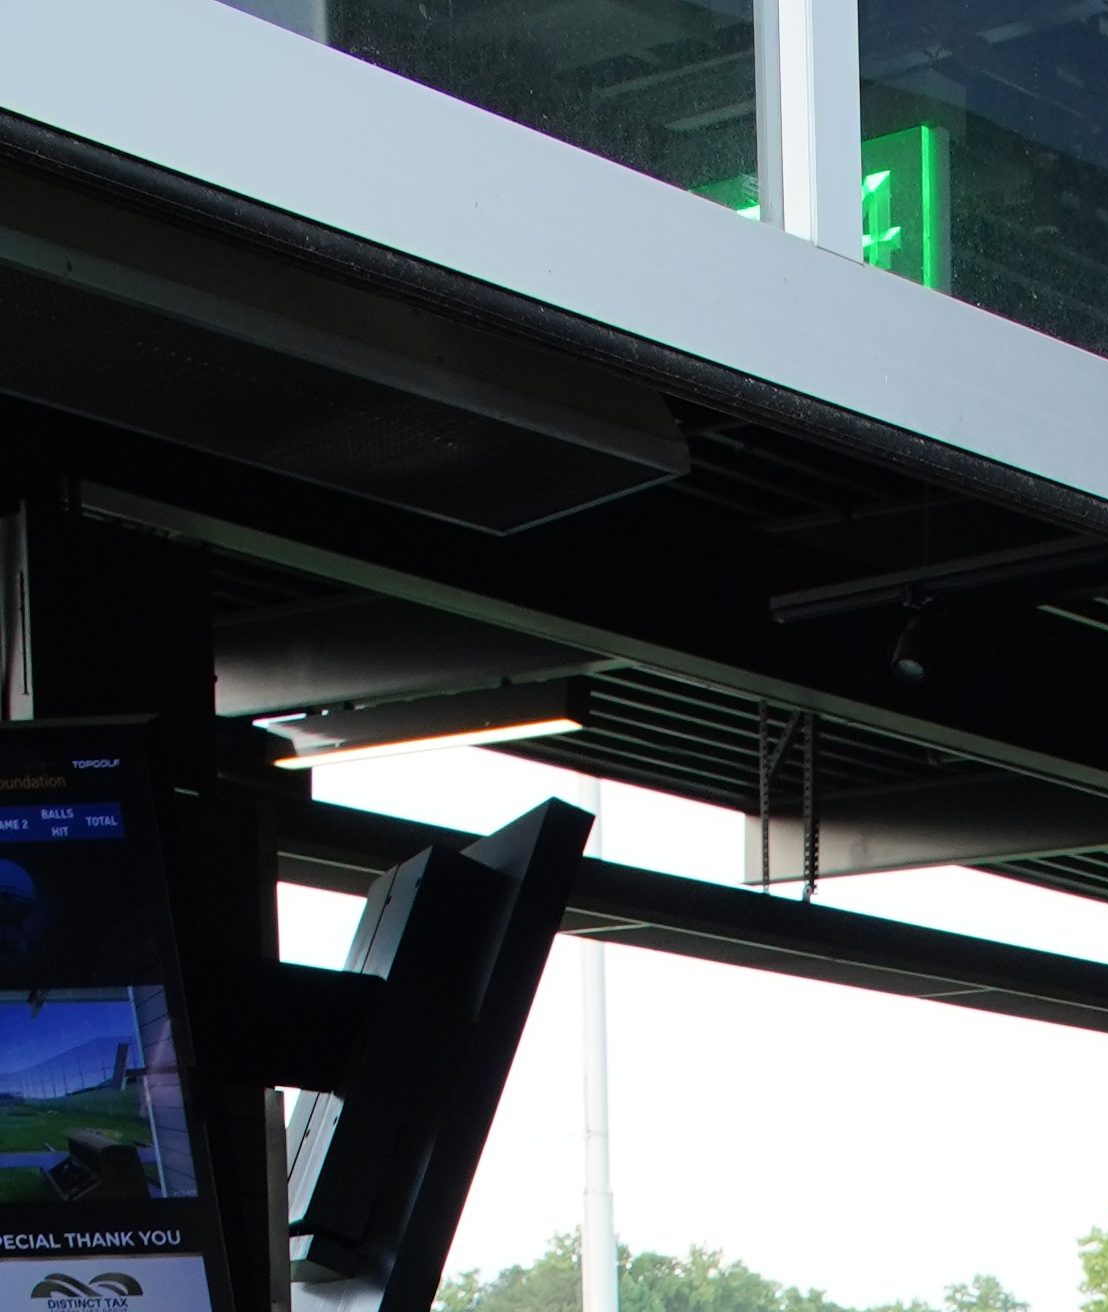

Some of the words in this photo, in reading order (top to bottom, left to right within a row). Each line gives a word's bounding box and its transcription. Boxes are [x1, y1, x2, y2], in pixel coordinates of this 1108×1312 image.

[72, 759, 120, 768] TOPGOLF
[41, 808, 74, 819] BALLS
[22, 818, 30, 830] 2
[85, 815, 118, 826] TOTAL
[51, 826, 68, 837] HIT
[0, 1233, 61, 1250] ECIAL
[64, 1231, 135, 1249] THANK
[138, 1229, 181, 1246] YOU
[47, 1298, 101, 1310] DISTINCT
[104, 1297, 129, 1308] TAX
